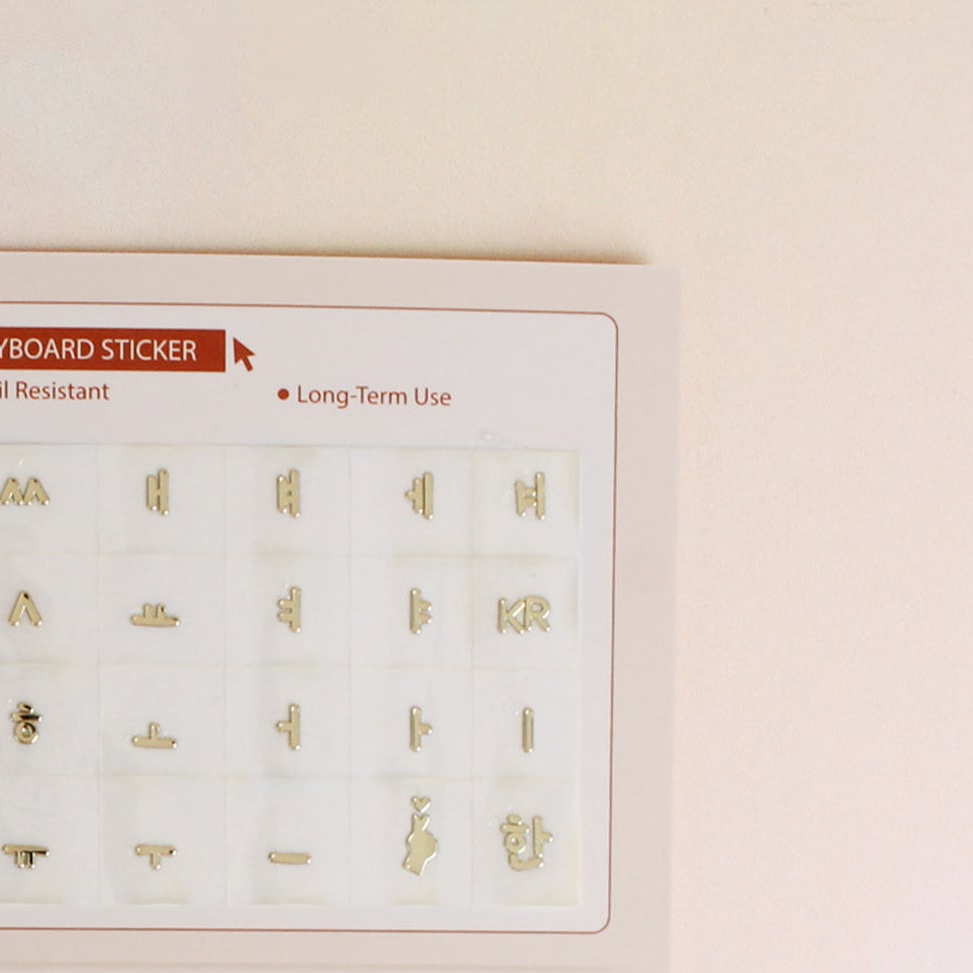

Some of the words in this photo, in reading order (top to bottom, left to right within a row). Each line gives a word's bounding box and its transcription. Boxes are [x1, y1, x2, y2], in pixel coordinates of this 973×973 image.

[102, 339, 196, 361] STICKER
[16, 381, 109, 400] Resistant
[298, 385, 407, 409] Long-Term
[415, 387, 451, 406] Use
[496, 595, 550, 634] KR
[499, 813, 553, 872] 한
